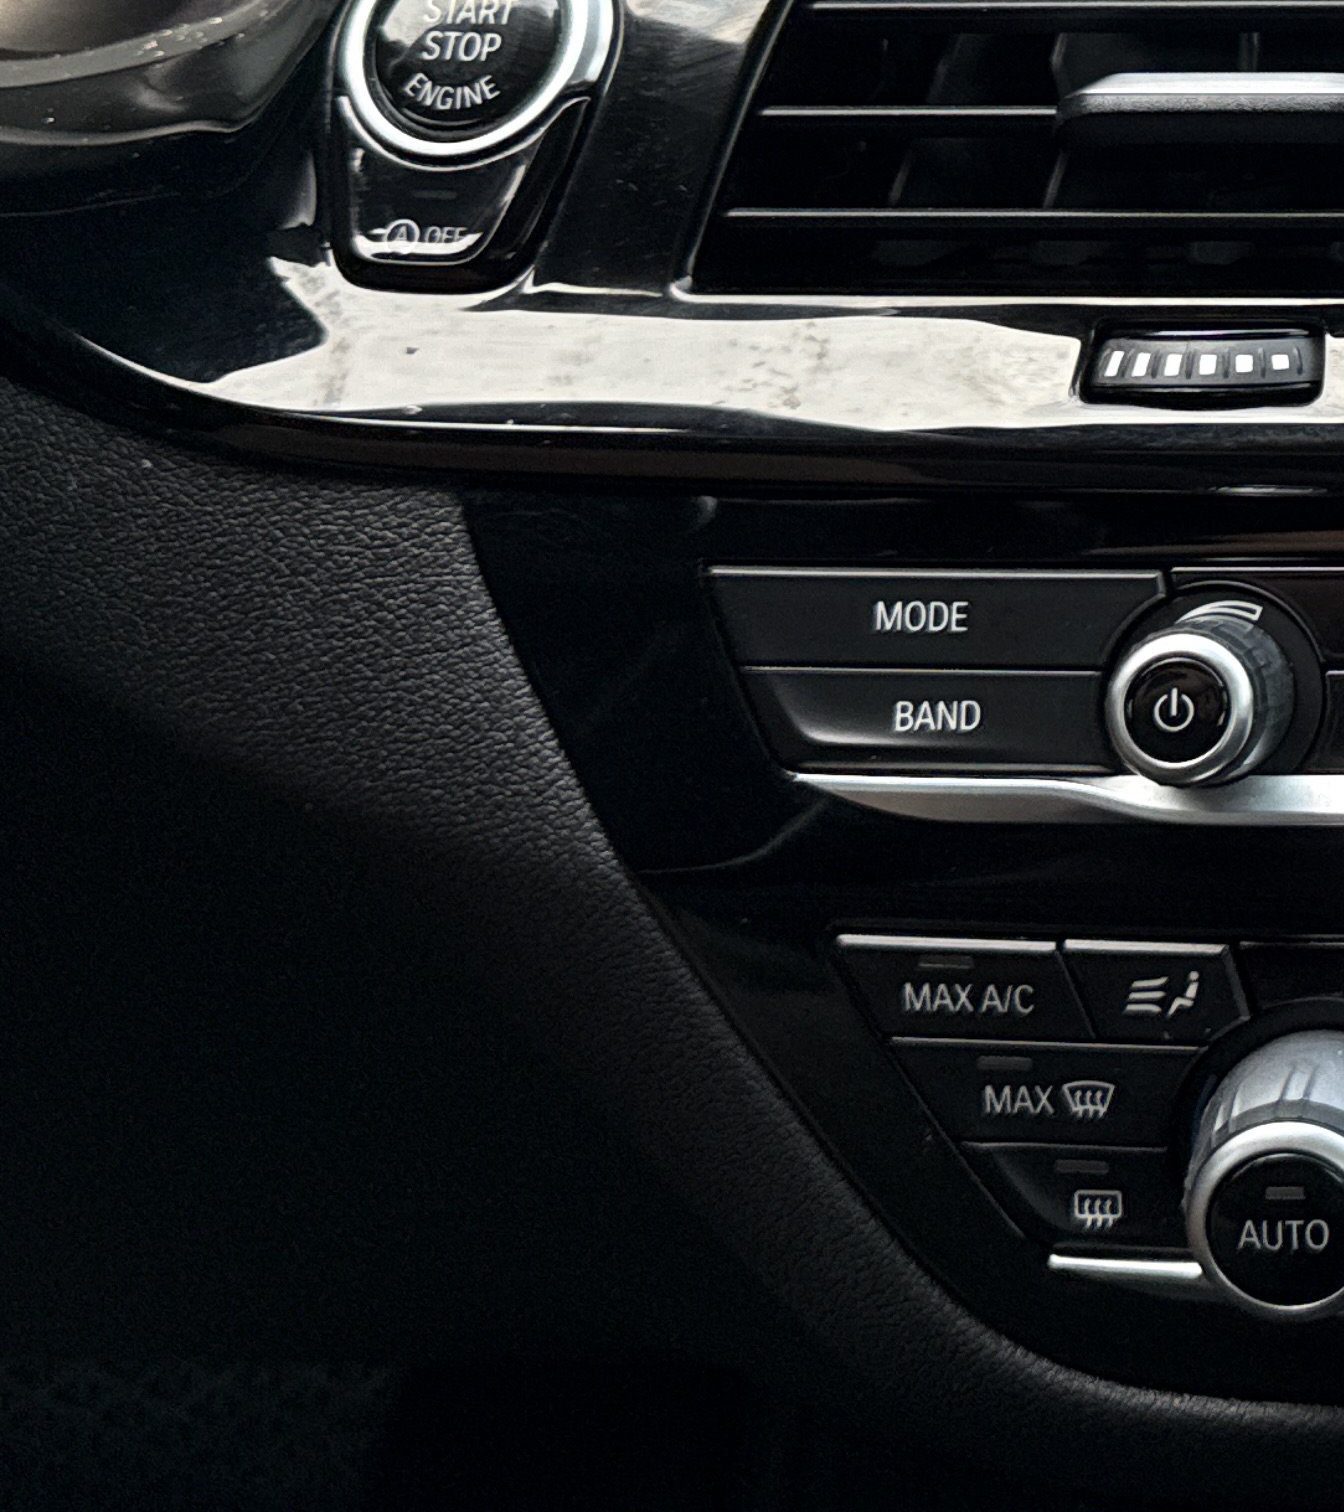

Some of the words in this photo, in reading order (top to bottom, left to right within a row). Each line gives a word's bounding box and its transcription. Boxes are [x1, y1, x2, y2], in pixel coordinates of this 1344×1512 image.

[421, 30, 503, 62] STOP
[402, 72, 502, 112] ENGINE
[873, 600, 970, 633] MODE
[894, 699, 982, 732] BAND
[903, 983, 975, 1013] MAX
[978, 984, 1035, 1015] A/C
[983, 1085, 1055, 1116] MAX
[1237, 1219, 1331, 1251] AUTO
